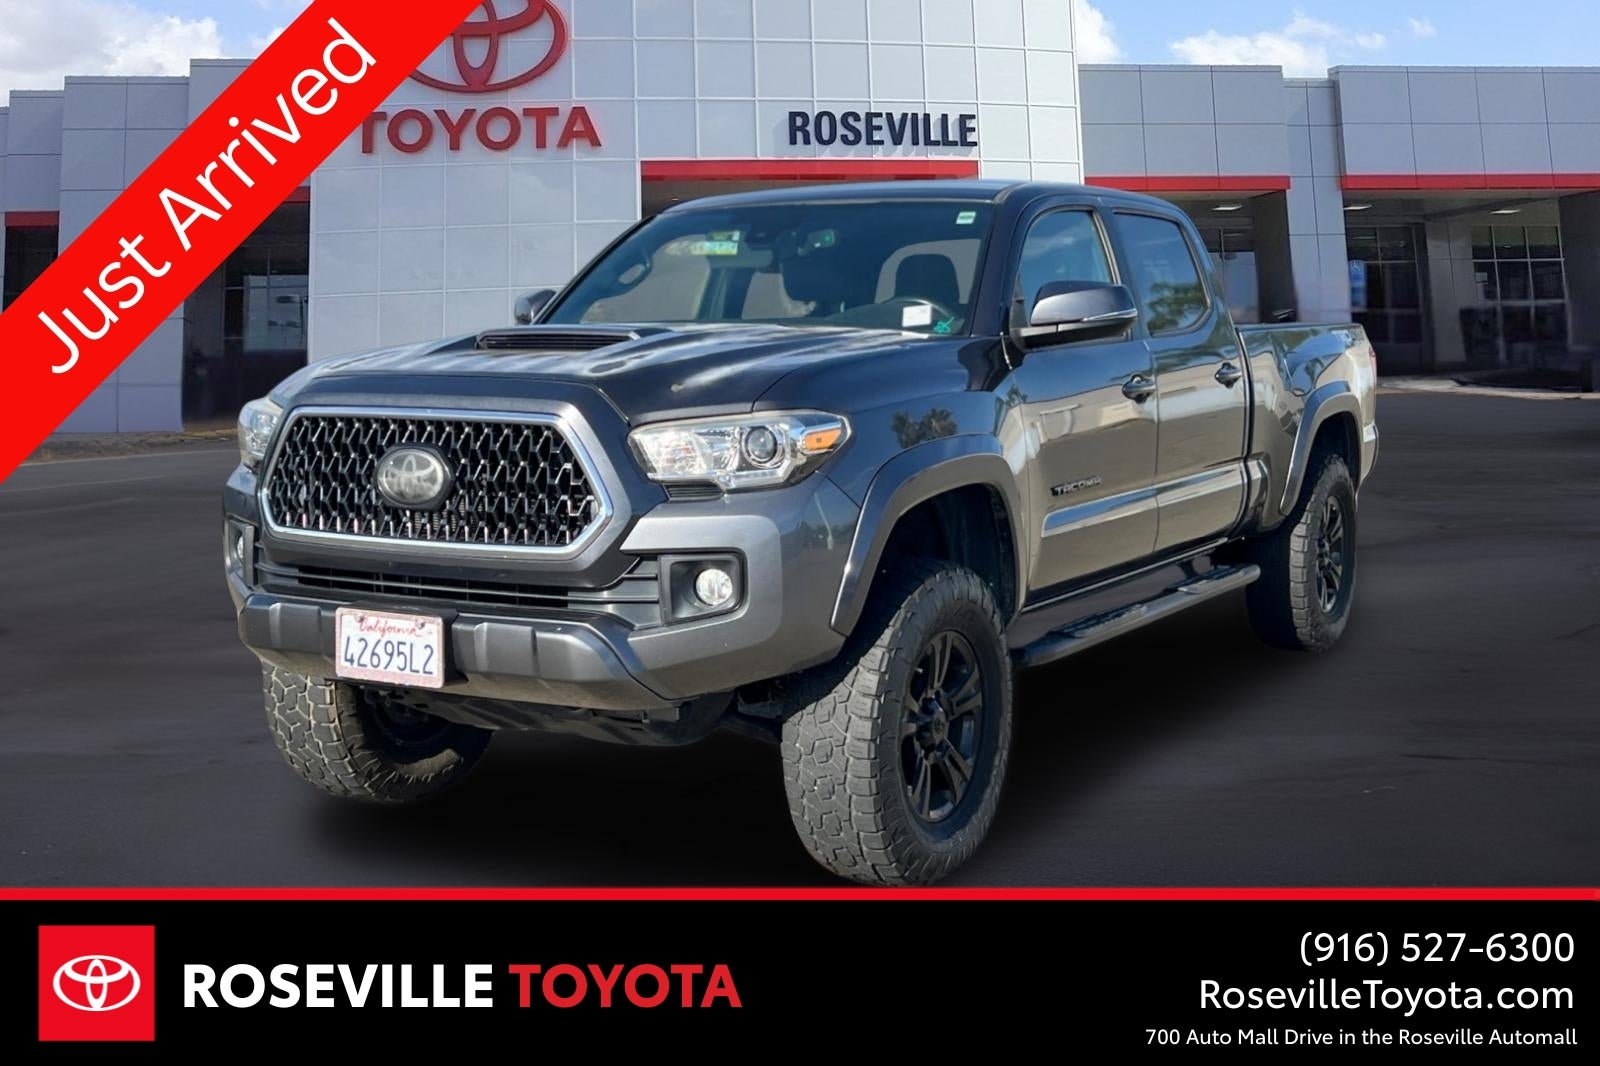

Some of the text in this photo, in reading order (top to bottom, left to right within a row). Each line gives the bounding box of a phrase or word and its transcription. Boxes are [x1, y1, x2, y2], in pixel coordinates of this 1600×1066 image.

[361, 106, 602, 154] TOYOTA
[788, 110, 978, 148] ROSEVILLE
[358, 616, 420, 637] California
[344, 636, 434, 675] 42695L2
